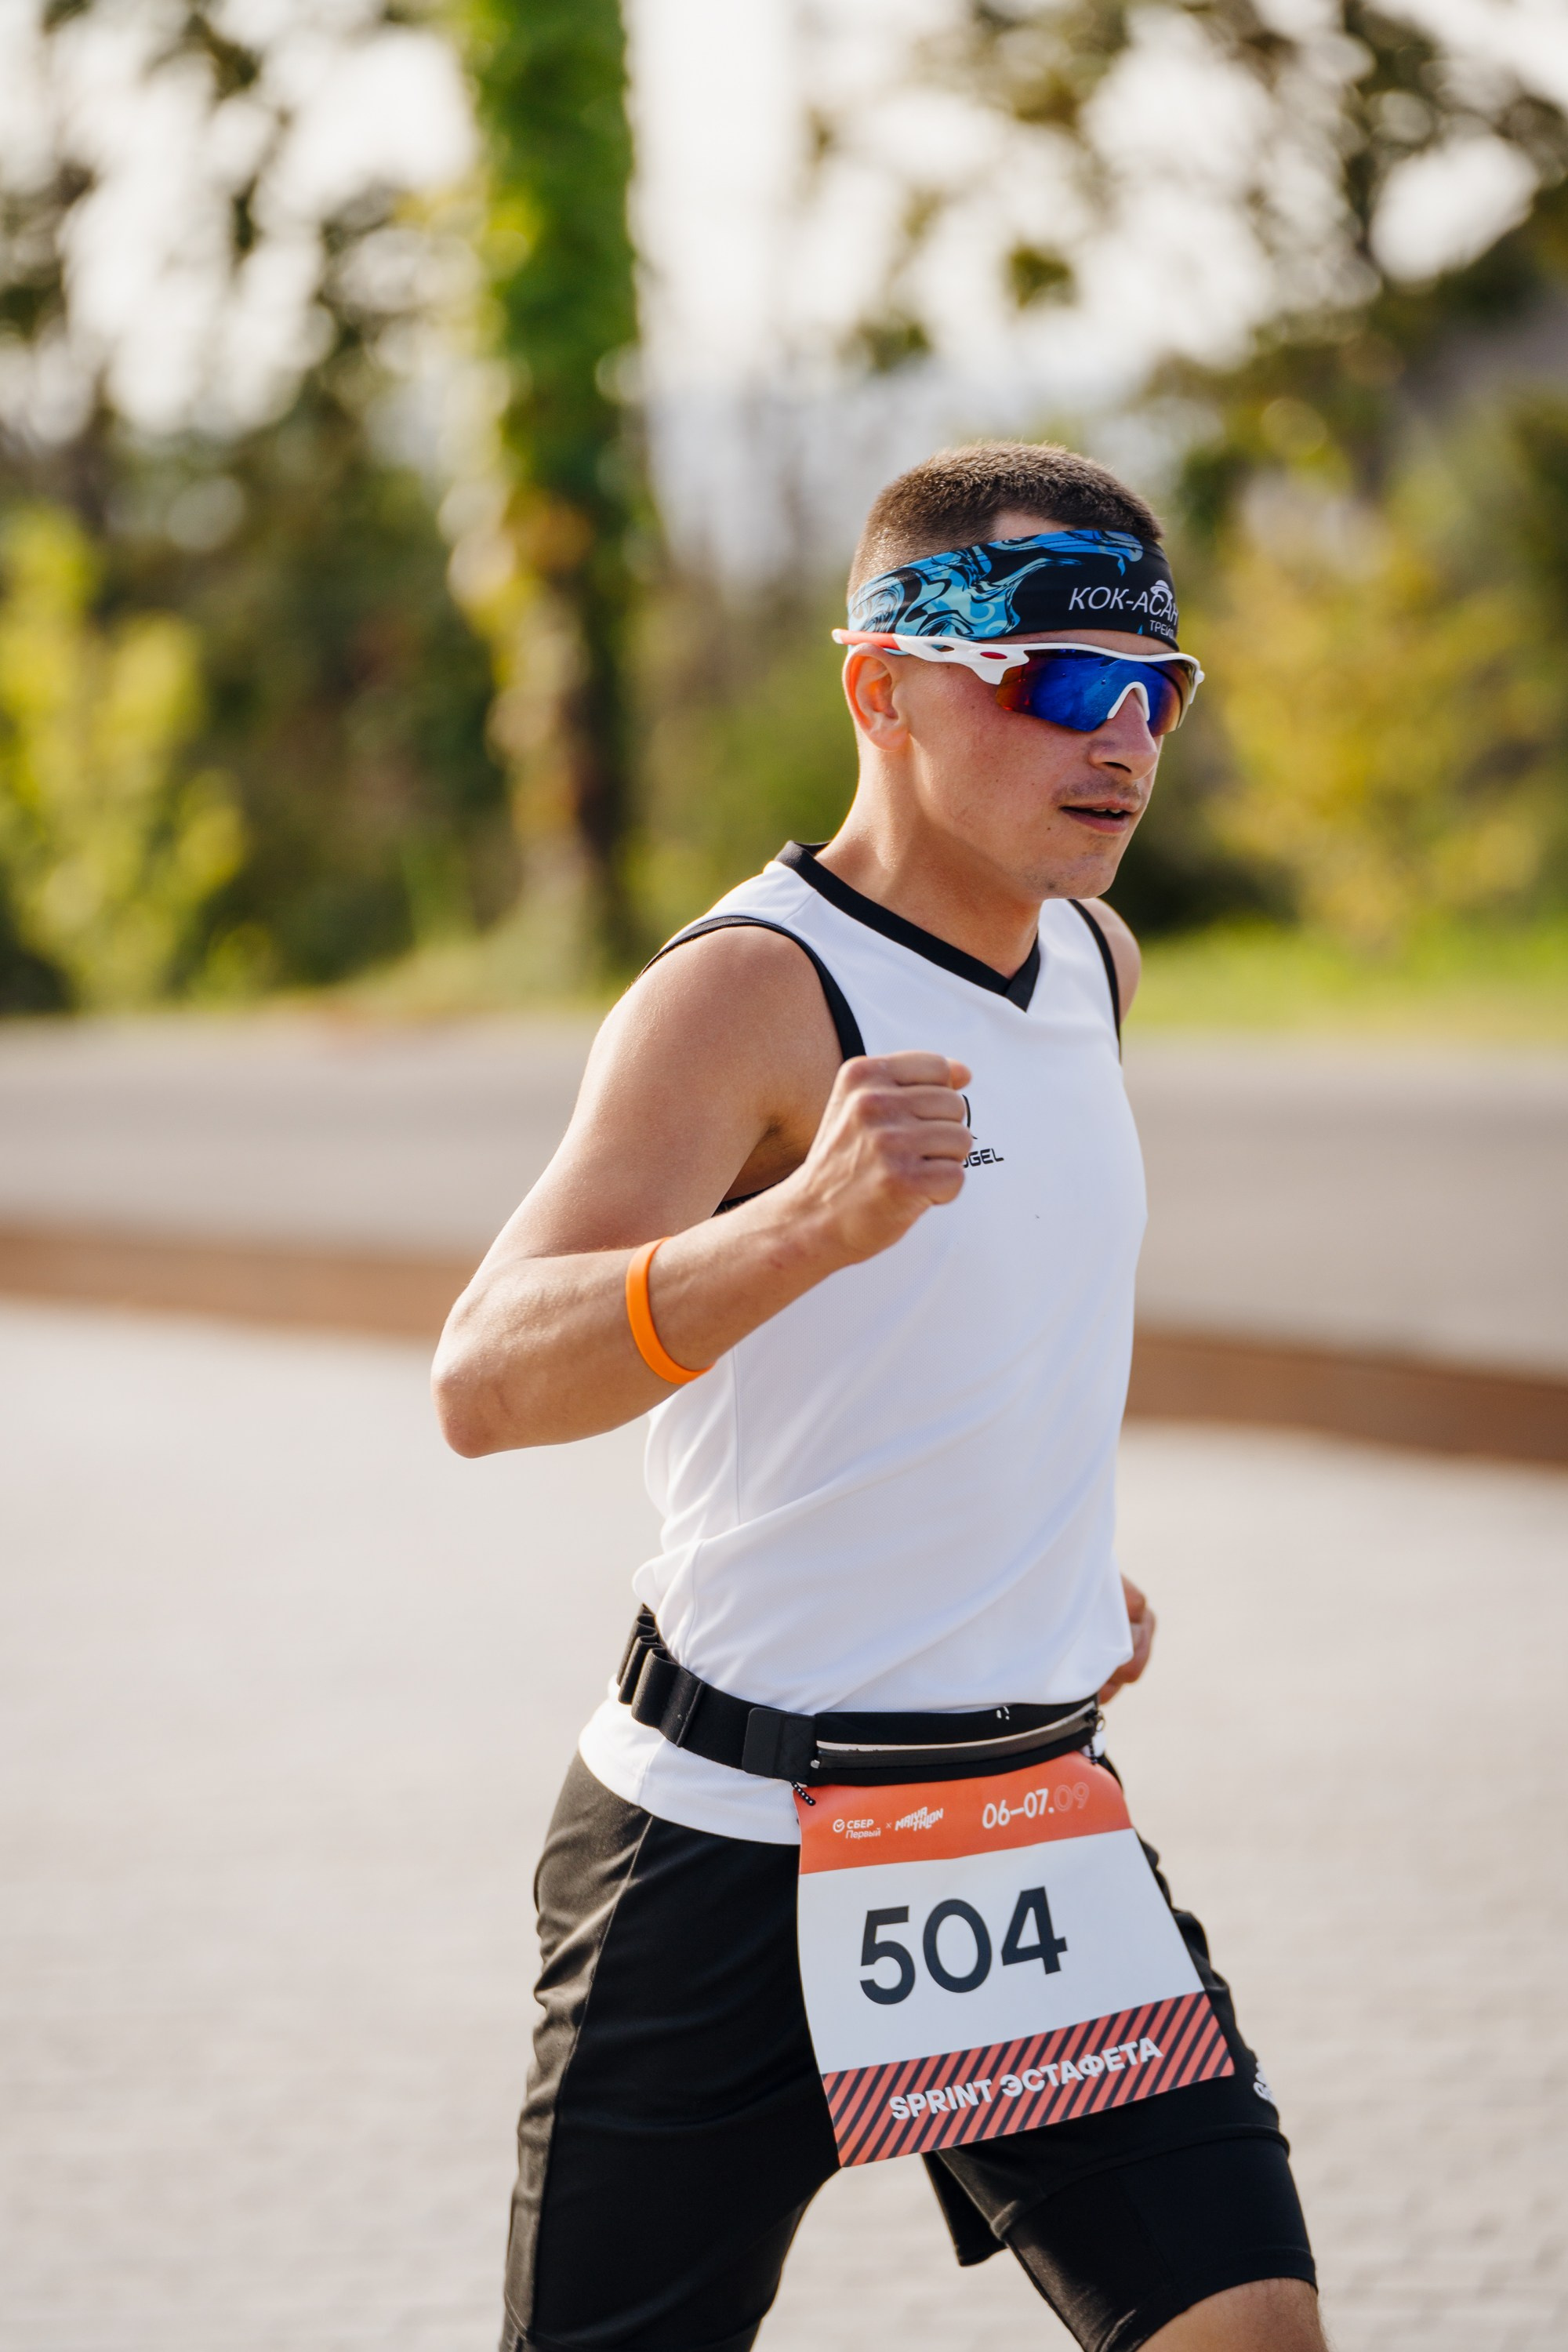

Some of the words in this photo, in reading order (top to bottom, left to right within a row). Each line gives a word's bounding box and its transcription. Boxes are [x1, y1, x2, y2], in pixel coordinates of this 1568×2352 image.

[845, 1828, 881, 1840] Первый
[846, 1818, 874, 1830] СБЕР
[859, 1885, 1068, 2005] 504
[889, 2078, 993, 2120] SPRINT
[999, 2037, 1163, 2099] ЭСТАФЕТА
